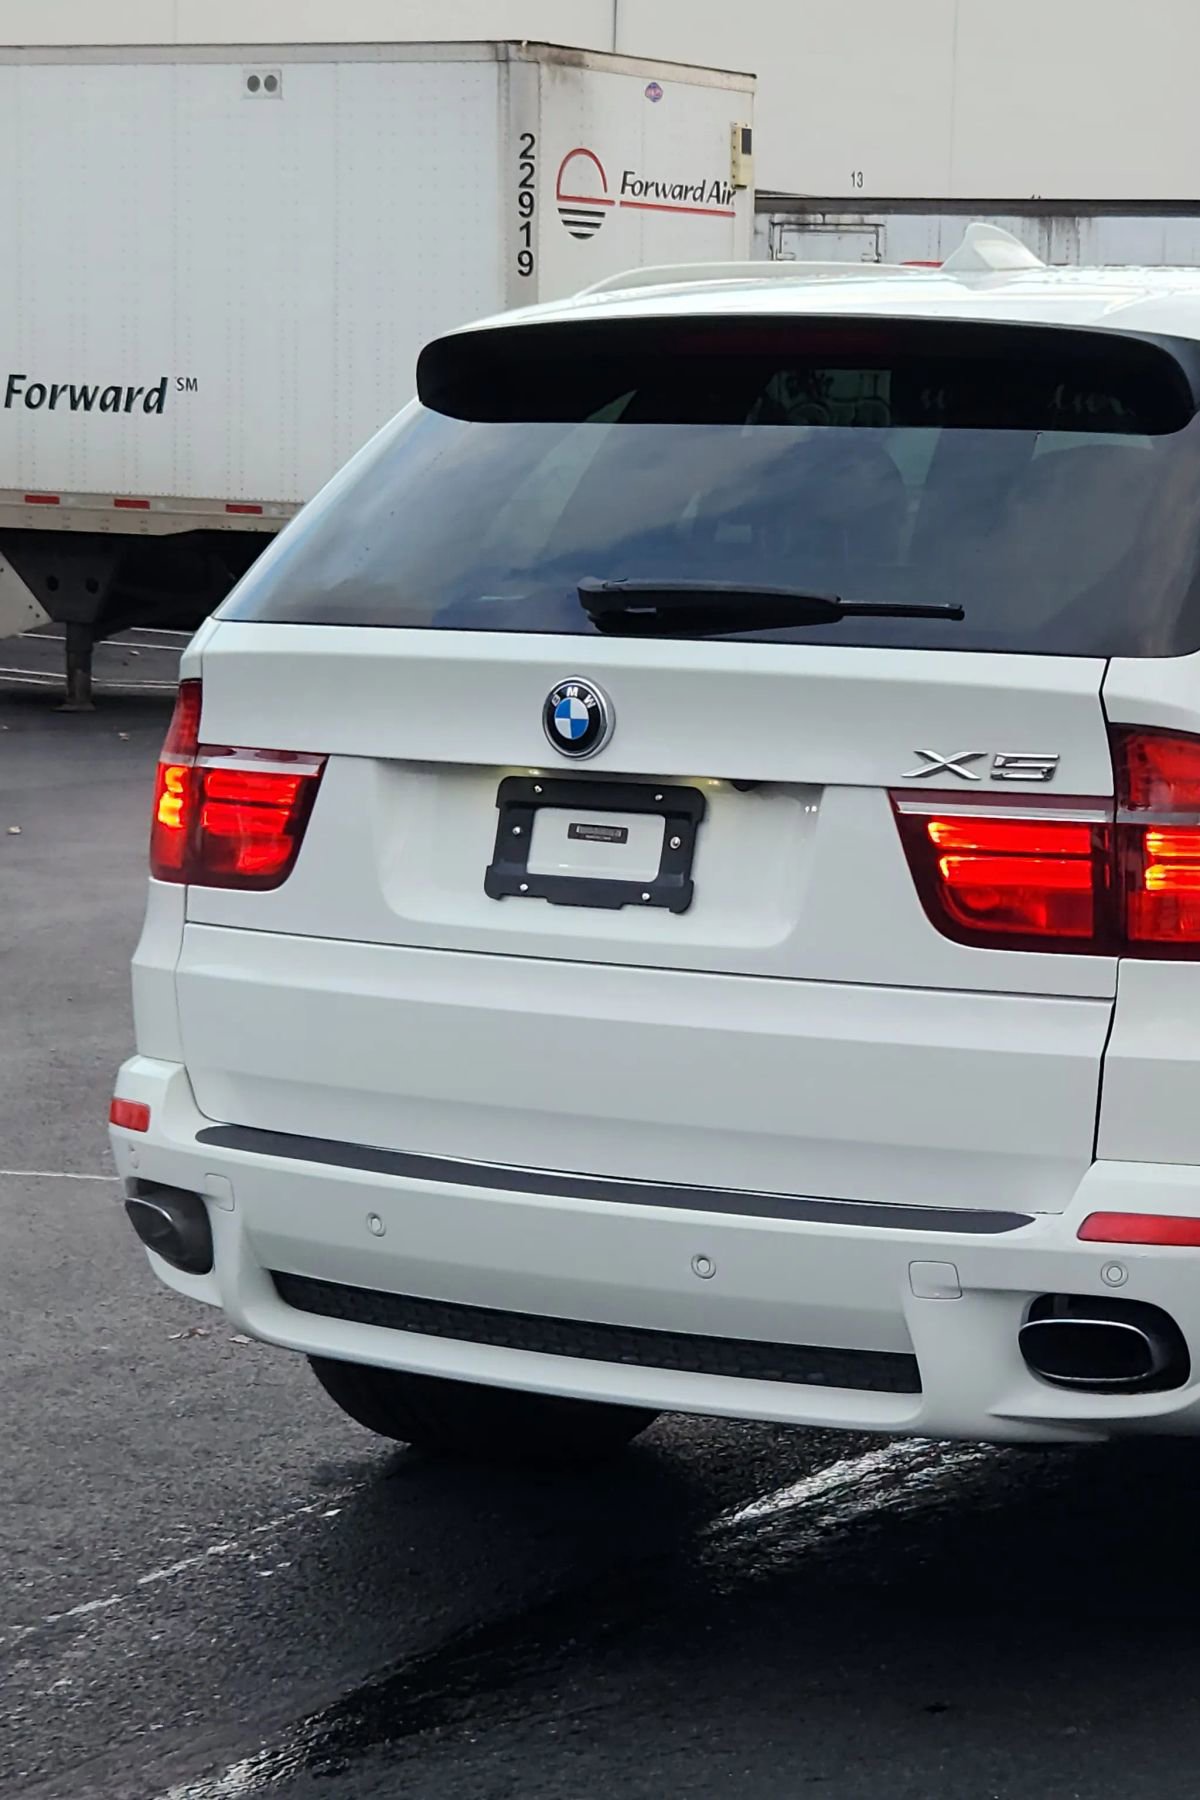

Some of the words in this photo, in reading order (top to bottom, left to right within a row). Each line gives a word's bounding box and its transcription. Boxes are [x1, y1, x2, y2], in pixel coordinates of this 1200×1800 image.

[620, 170, 706, 203] Forward
[706, 180, 736, 206] Air
[851, 170, 864, 188] 13
[517, 132, 536, 277] 22919
[4, 374, 168, 414] Forward
[176, 377, 198, 392] SM
[551, 686, 597, 709] BMW
[901, 749, 1060, 782] X5
